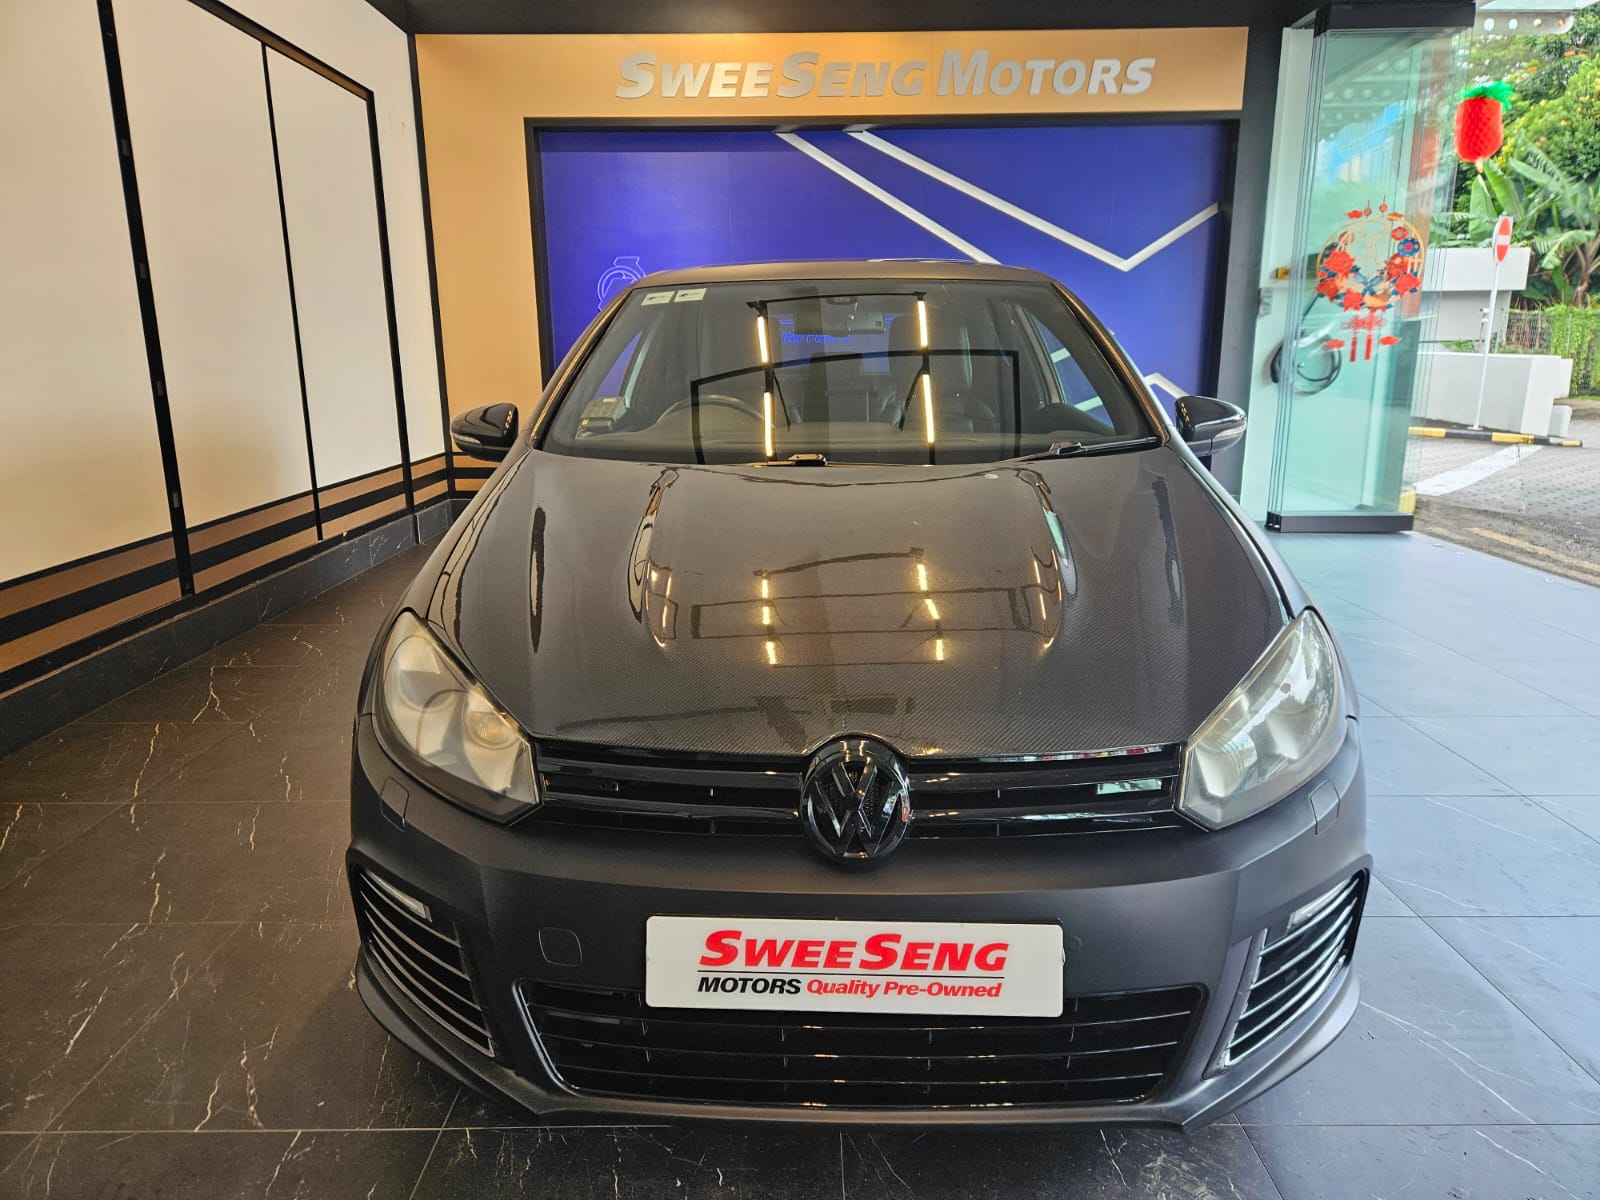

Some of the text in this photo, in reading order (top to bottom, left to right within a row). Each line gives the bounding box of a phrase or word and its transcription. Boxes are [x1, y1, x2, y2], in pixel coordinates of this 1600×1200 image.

[937, 49, 1157, 96] MOTORS
[697, 977, 1003, 998] MOTORS Quality Pre-Owned
